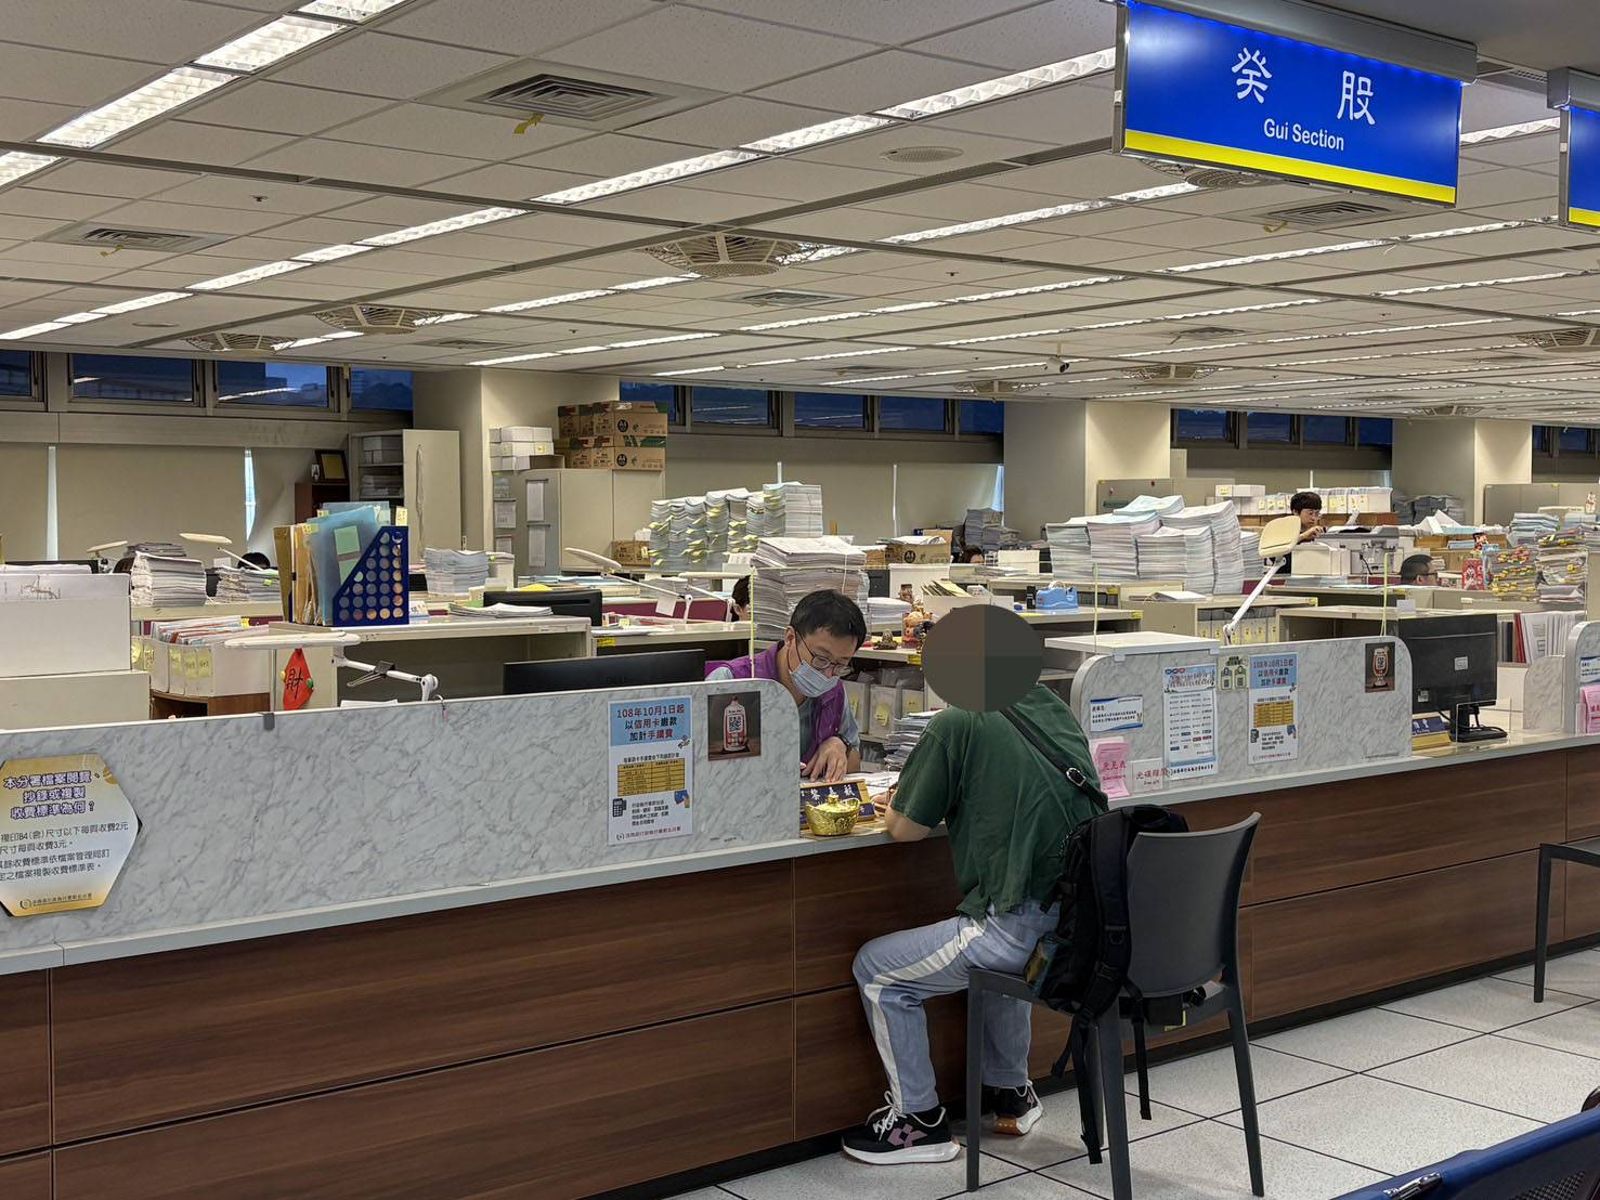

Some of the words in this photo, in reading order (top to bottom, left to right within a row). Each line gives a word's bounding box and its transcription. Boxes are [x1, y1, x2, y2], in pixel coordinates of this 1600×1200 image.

[1263, 117, 1289, 141] Gui
[1292, 123, 1345, 151] Section
[617, 704, 685, 718] 108年10月1日起
[625, 716, 677, 730] 以信用卡繳款
[629, 728, 674, 742] 加計手續費
[23, 786, 86, 804] 抄錄或複製
